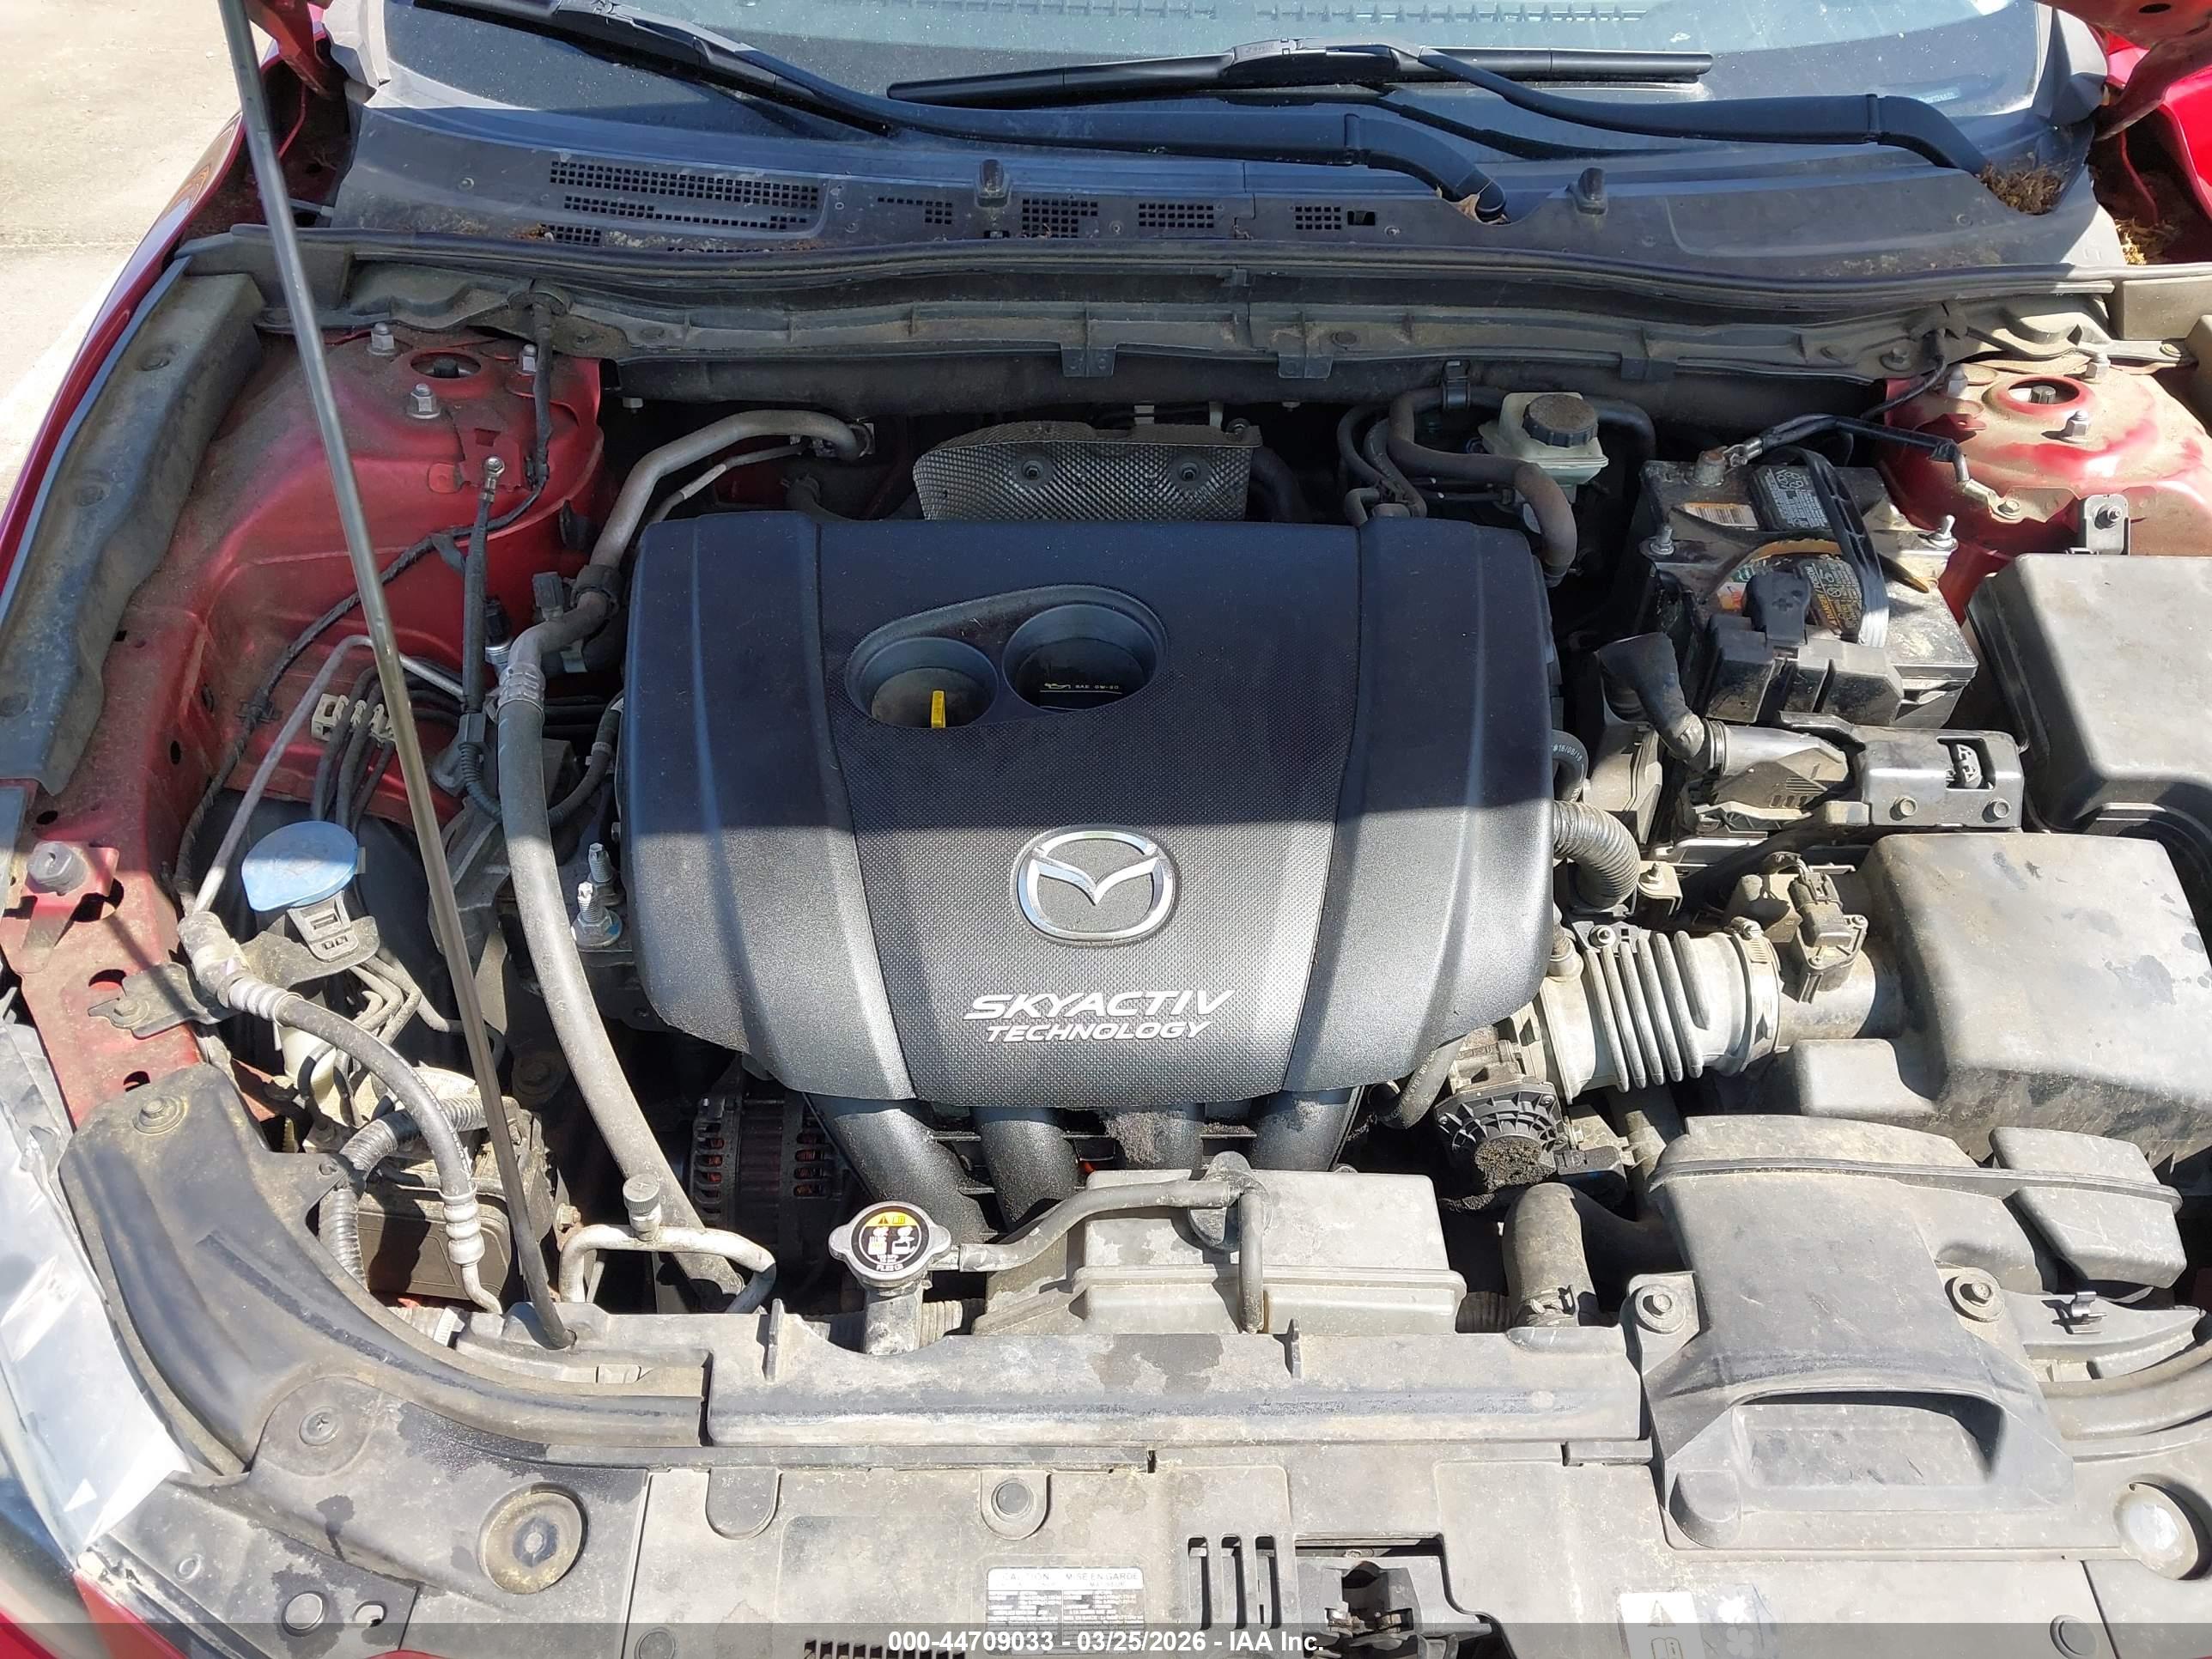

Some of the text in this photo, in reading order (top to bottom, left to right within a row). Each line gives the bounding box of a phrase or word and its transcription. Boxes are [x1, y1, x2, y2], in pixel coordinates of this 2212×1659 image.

[1805, 566, 1821, 589] POISON
[1816, 593, 1835, 620] DANGER
[963, 989, 1237, 1021] SKYACTIV
[987, 1020, 1213, 1043] TECHNOLOGY
[1105, 1572, 1139, 1581] GARDE
